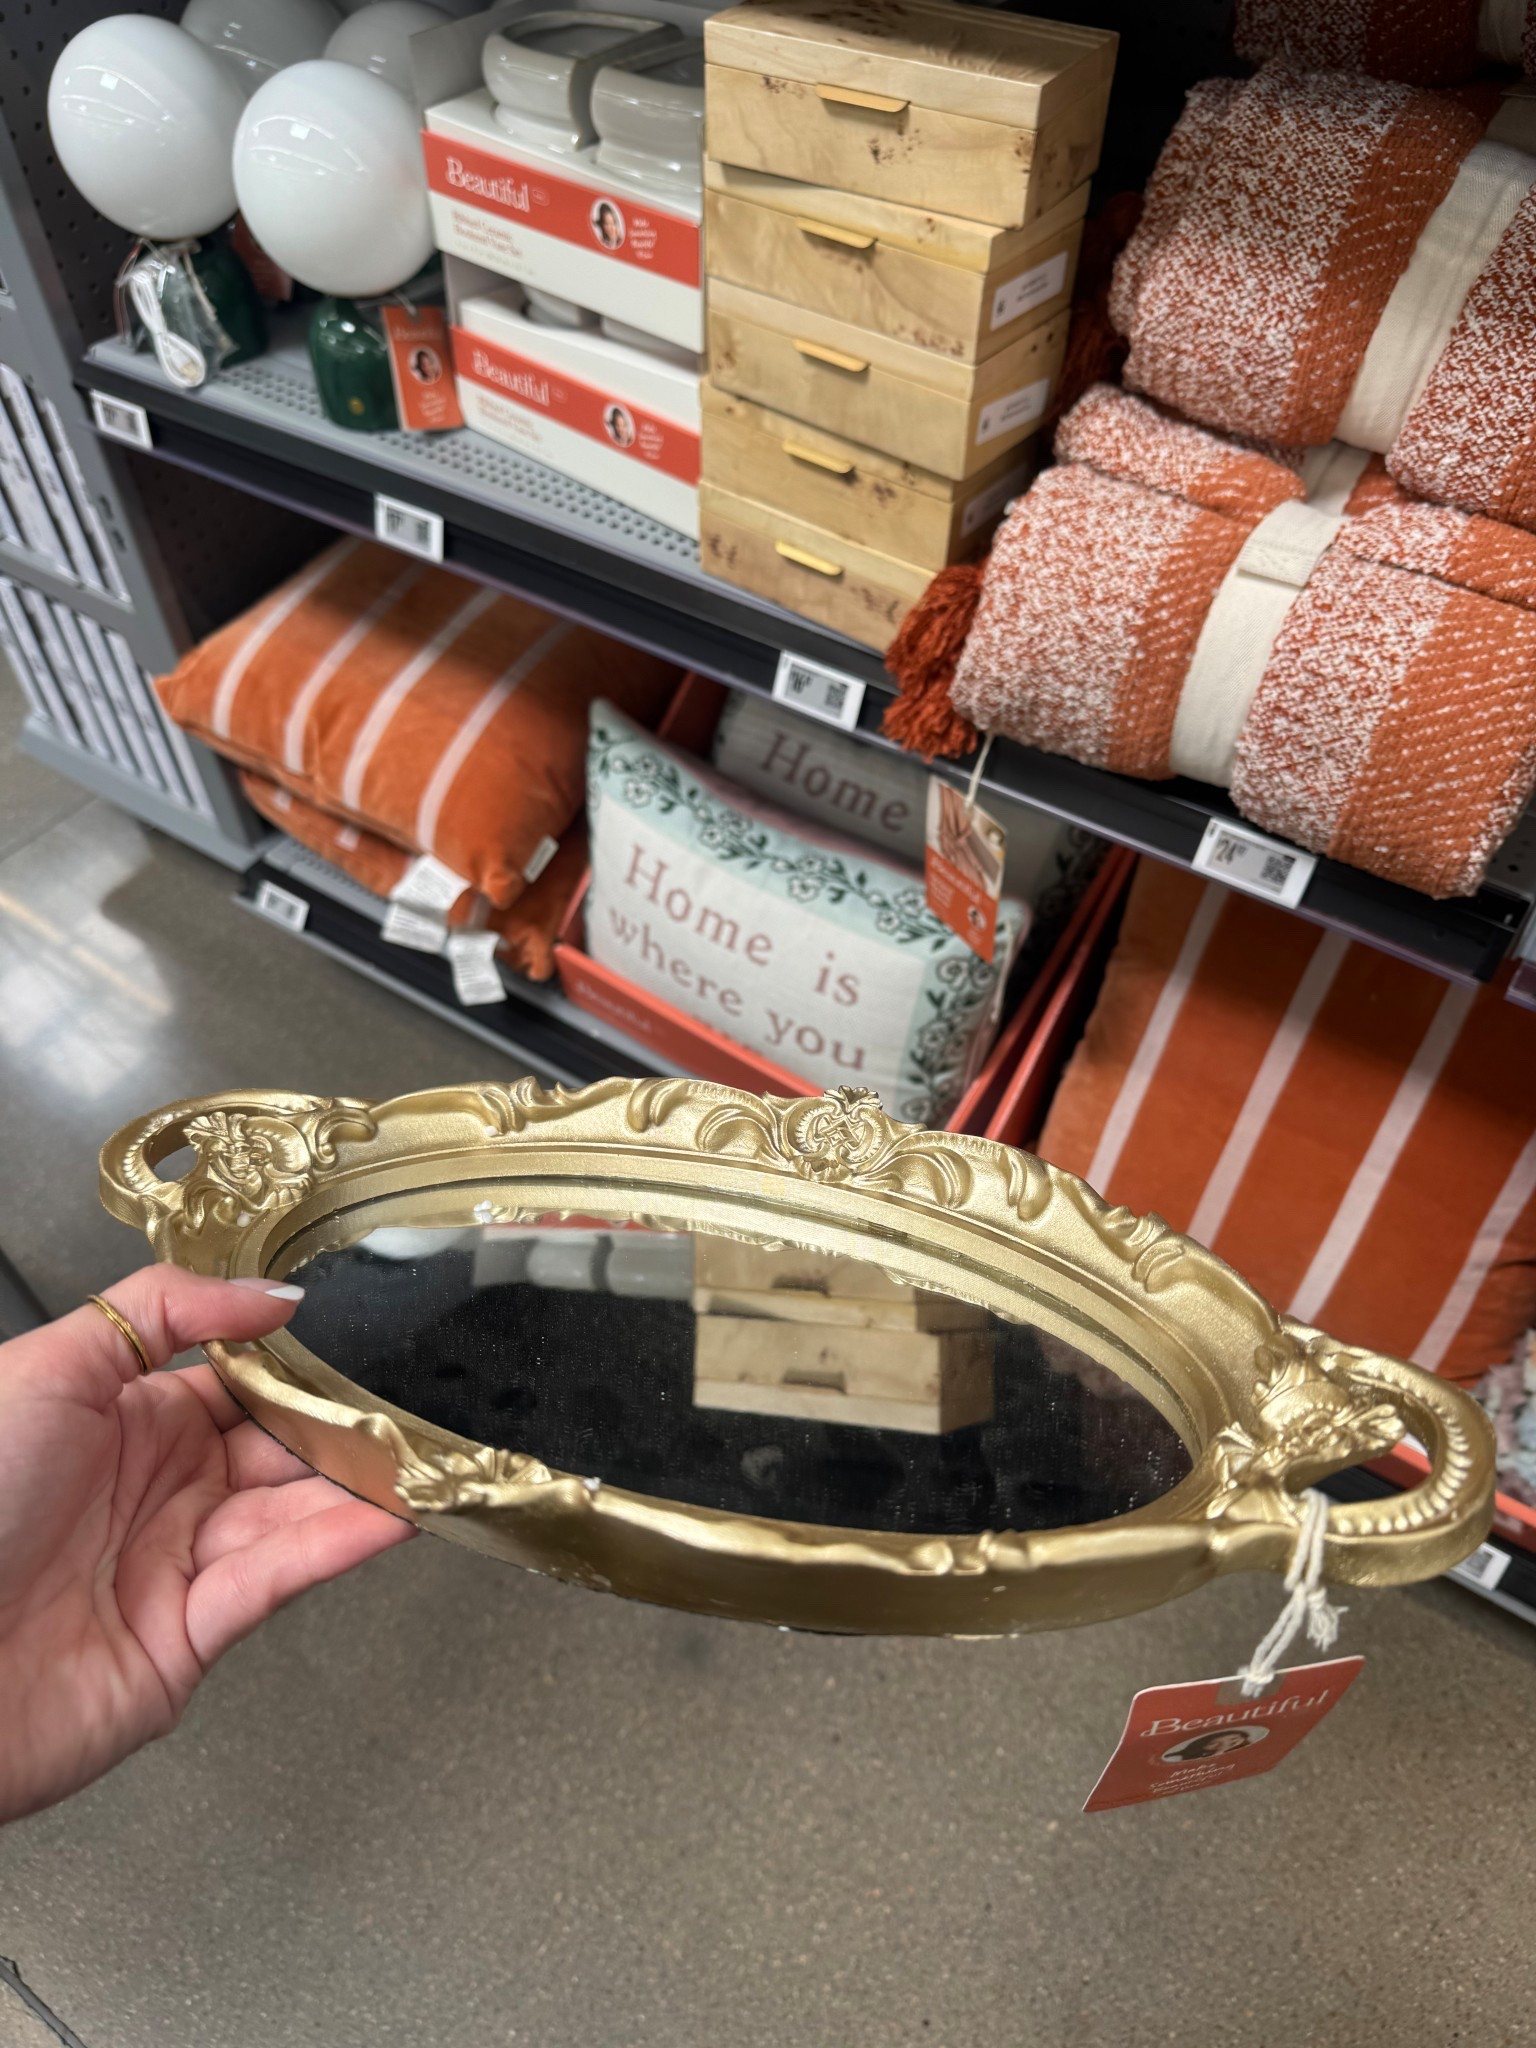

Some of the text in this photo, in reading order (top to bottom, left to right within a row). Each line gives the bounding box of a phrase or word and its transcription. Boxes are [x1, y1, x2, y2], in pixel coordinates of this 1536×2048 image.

[446, 156, 530, 213] Beautiful
[471, 348, 550, 407] Beautiful
[761, 732, 910, 832] Home
[623, 844, 862, 1008] Home is
[607, 907, 744, 1018] where
[765, 1010, 867, 1071] you
[1140, 1689, 1329, 1738] Beautiful
